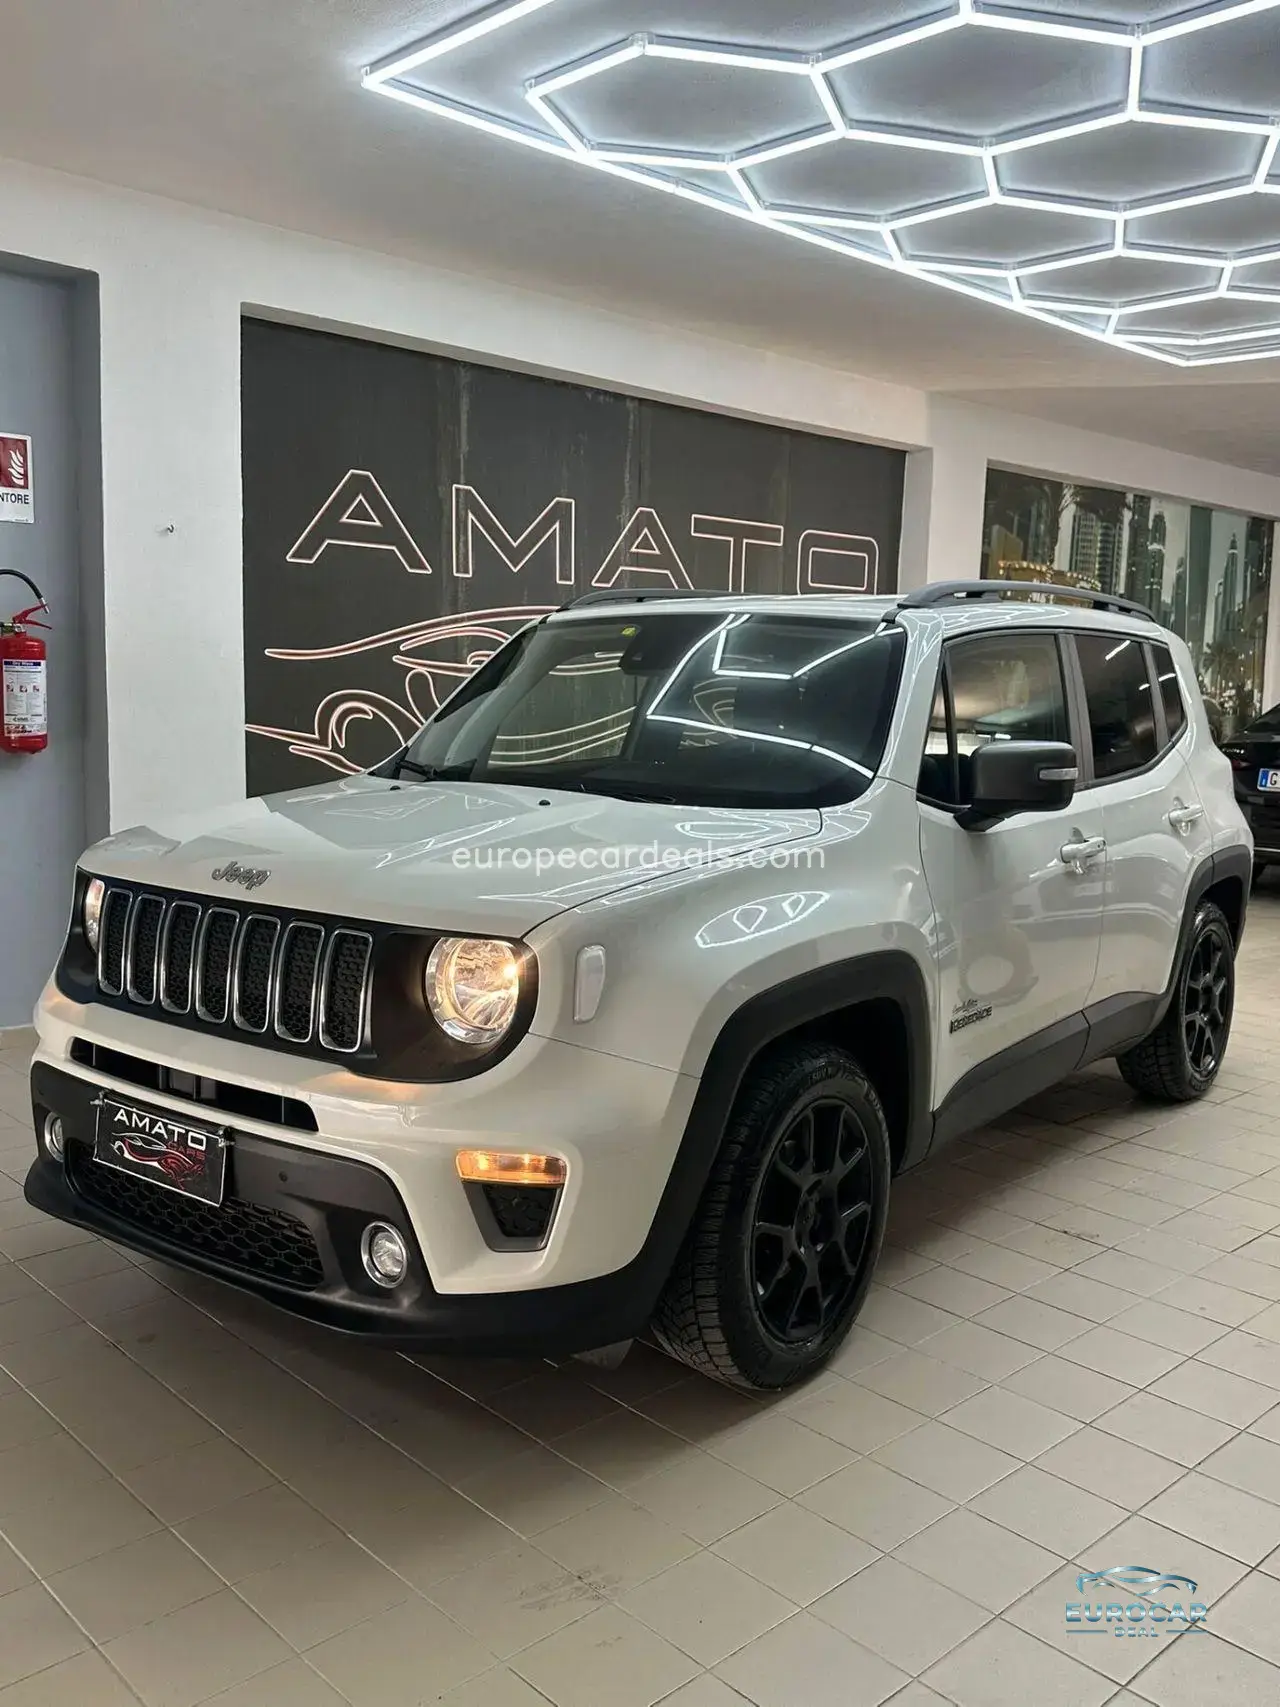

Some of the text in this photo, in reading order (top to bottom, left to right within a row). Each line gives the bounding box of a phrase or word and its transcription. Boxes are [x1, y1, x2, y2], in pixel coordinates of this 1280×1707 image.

[286, 469, 879, 596] AMATO
[211, 860, 272, 891] Jeep
[113, 1107, 207, 1152] AMATO
[166, 1140, 207, 1161] CARS
